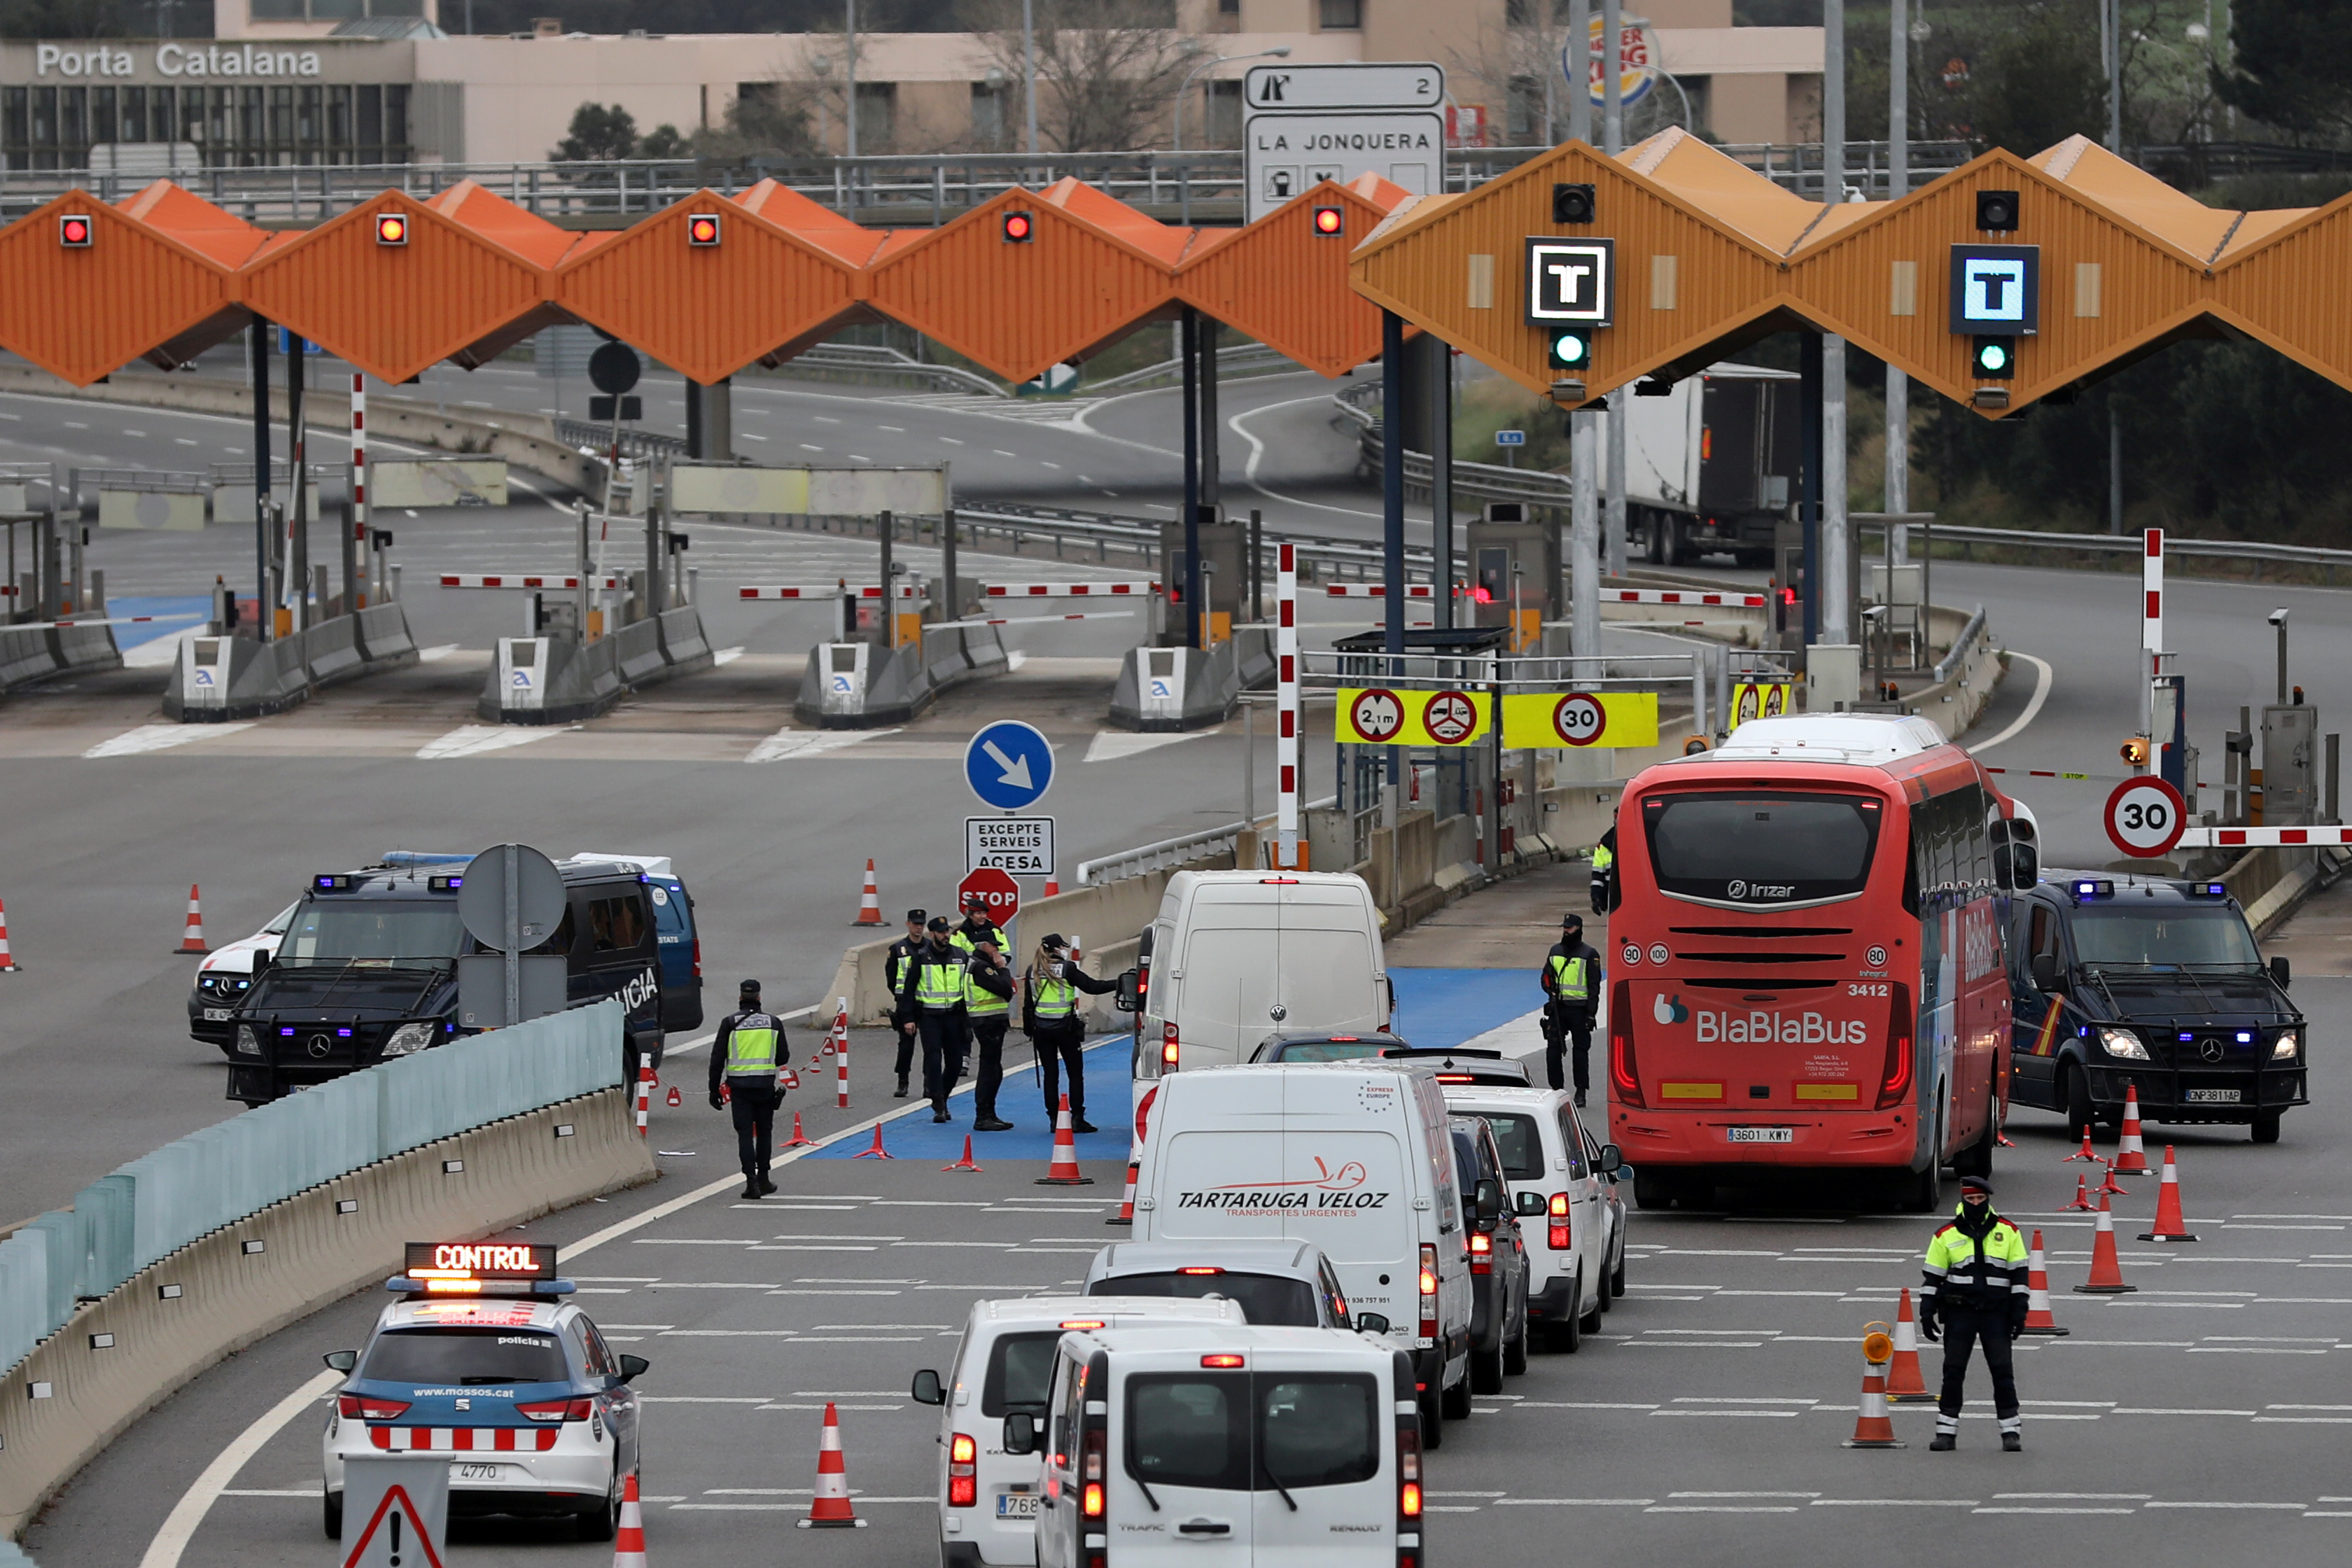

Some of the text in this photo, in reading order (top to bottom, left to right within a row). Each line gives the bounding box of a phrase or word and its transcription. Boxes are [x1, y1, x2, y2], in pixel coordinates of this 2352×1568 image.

[37, 43, 319, 77] Porta Catalana
[1416, 78, 1429, 94] 2
[1258, 135, 1288, 150] LA
[1303, 134, 1429, 150] JONQUERA
[1548, 265, 1590, 303] T
[1973, 272, 2015, 309] T
[1564, 709, 1595, 728] 30
[2124, 804, 2167, 830] 30
[979, 824, 1042, 834] EXCEPTE
[979, 836, 1041, 847] SERVEIS
[979, 856, 1042, 869] ACESA
[961, 891, 1016, 906] STOP
[1625, 948, 1639, 960] 90
[1651, 949, 1666, 960] 100
[1869, 950, 1884, 962] 80
[1848, 984, 1888, 997] 3412
[736, 1018, 770, 1028] OLICIA
[1697, 1011, 1866, 1044] BlaBlaBus
[1735, 1130, 1788, 1140] 3601 KWY
[1178, 1193, 1390, 1208] TARTARUGA VELOZ
[435, 1245, 540, 1270] CONTROL
[413, 1388, 514, 1399] www.mossos.cat
[461, 1465, 496, 1479] 4770
[1009, 1498, 1038, 1513] 768
[1118, 1523, 1166, 1532] TRAFIC
